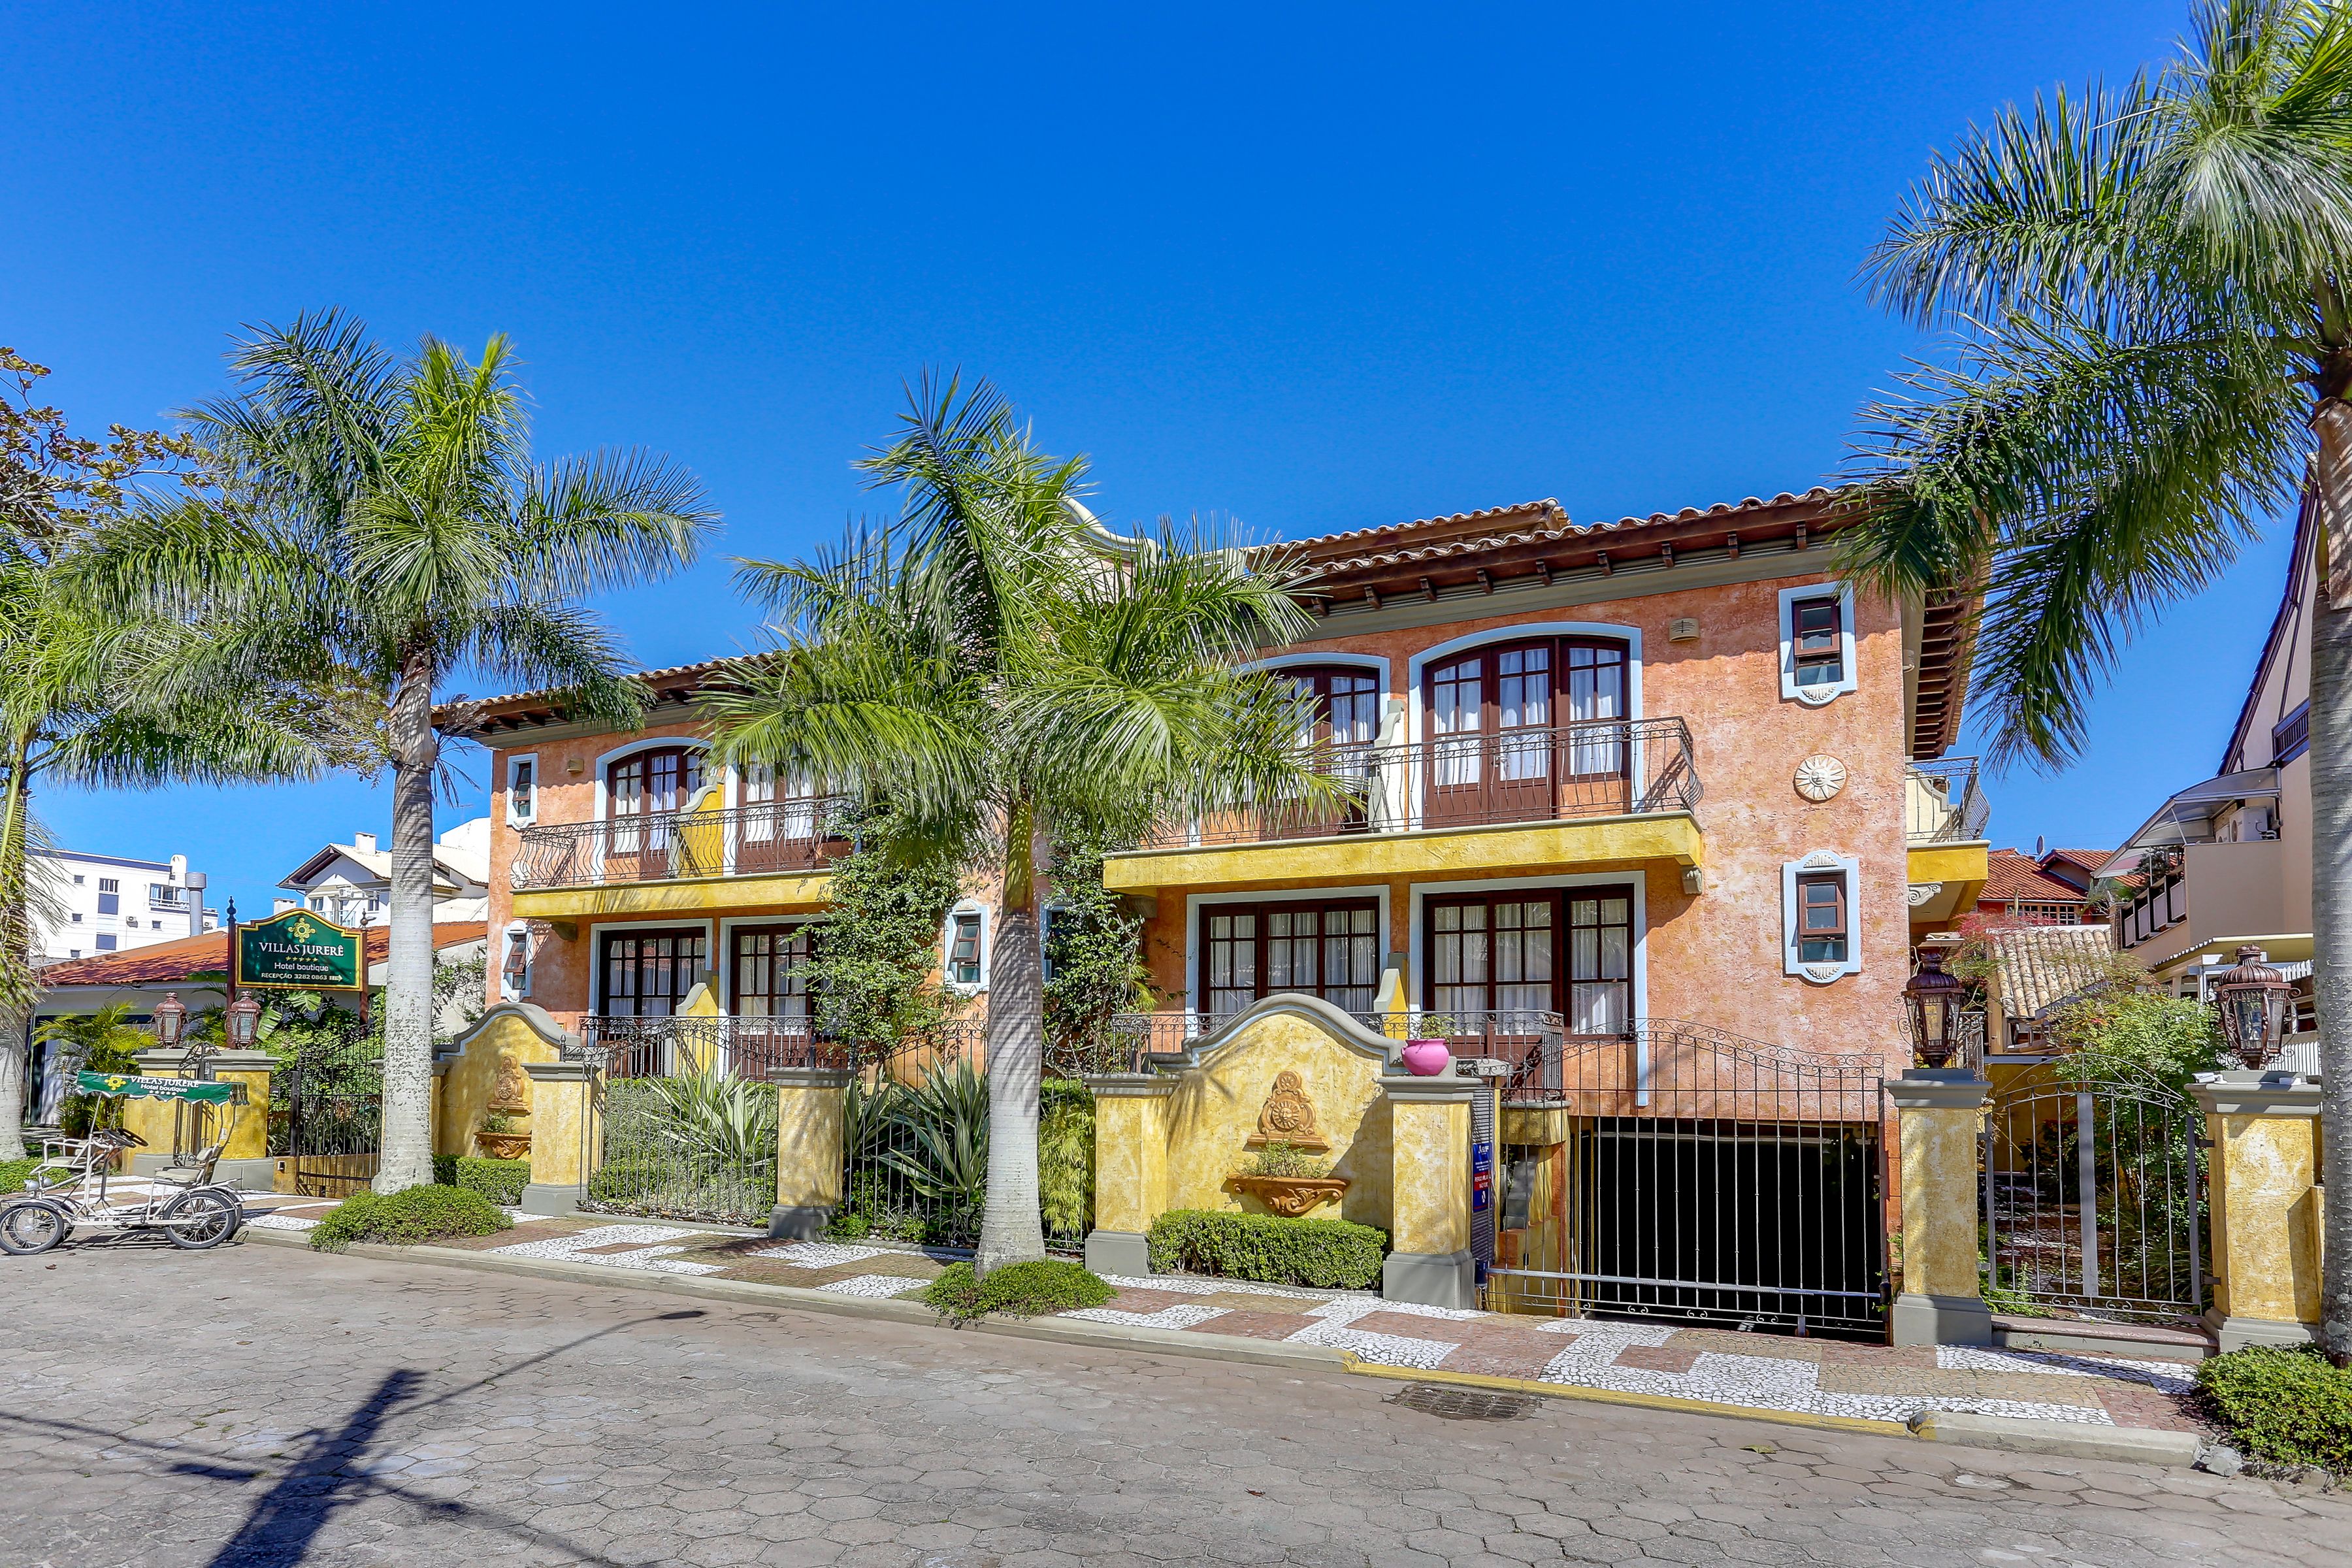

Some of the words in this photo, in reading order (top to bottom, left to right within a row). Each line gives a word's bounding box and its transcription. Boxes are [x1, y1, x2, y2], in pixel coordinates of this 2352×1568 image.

[259, 942, 300, 953] VILLAS
[301, 944, 344, 956] JURERÊ
[297, 964, 329, 972] boutique
